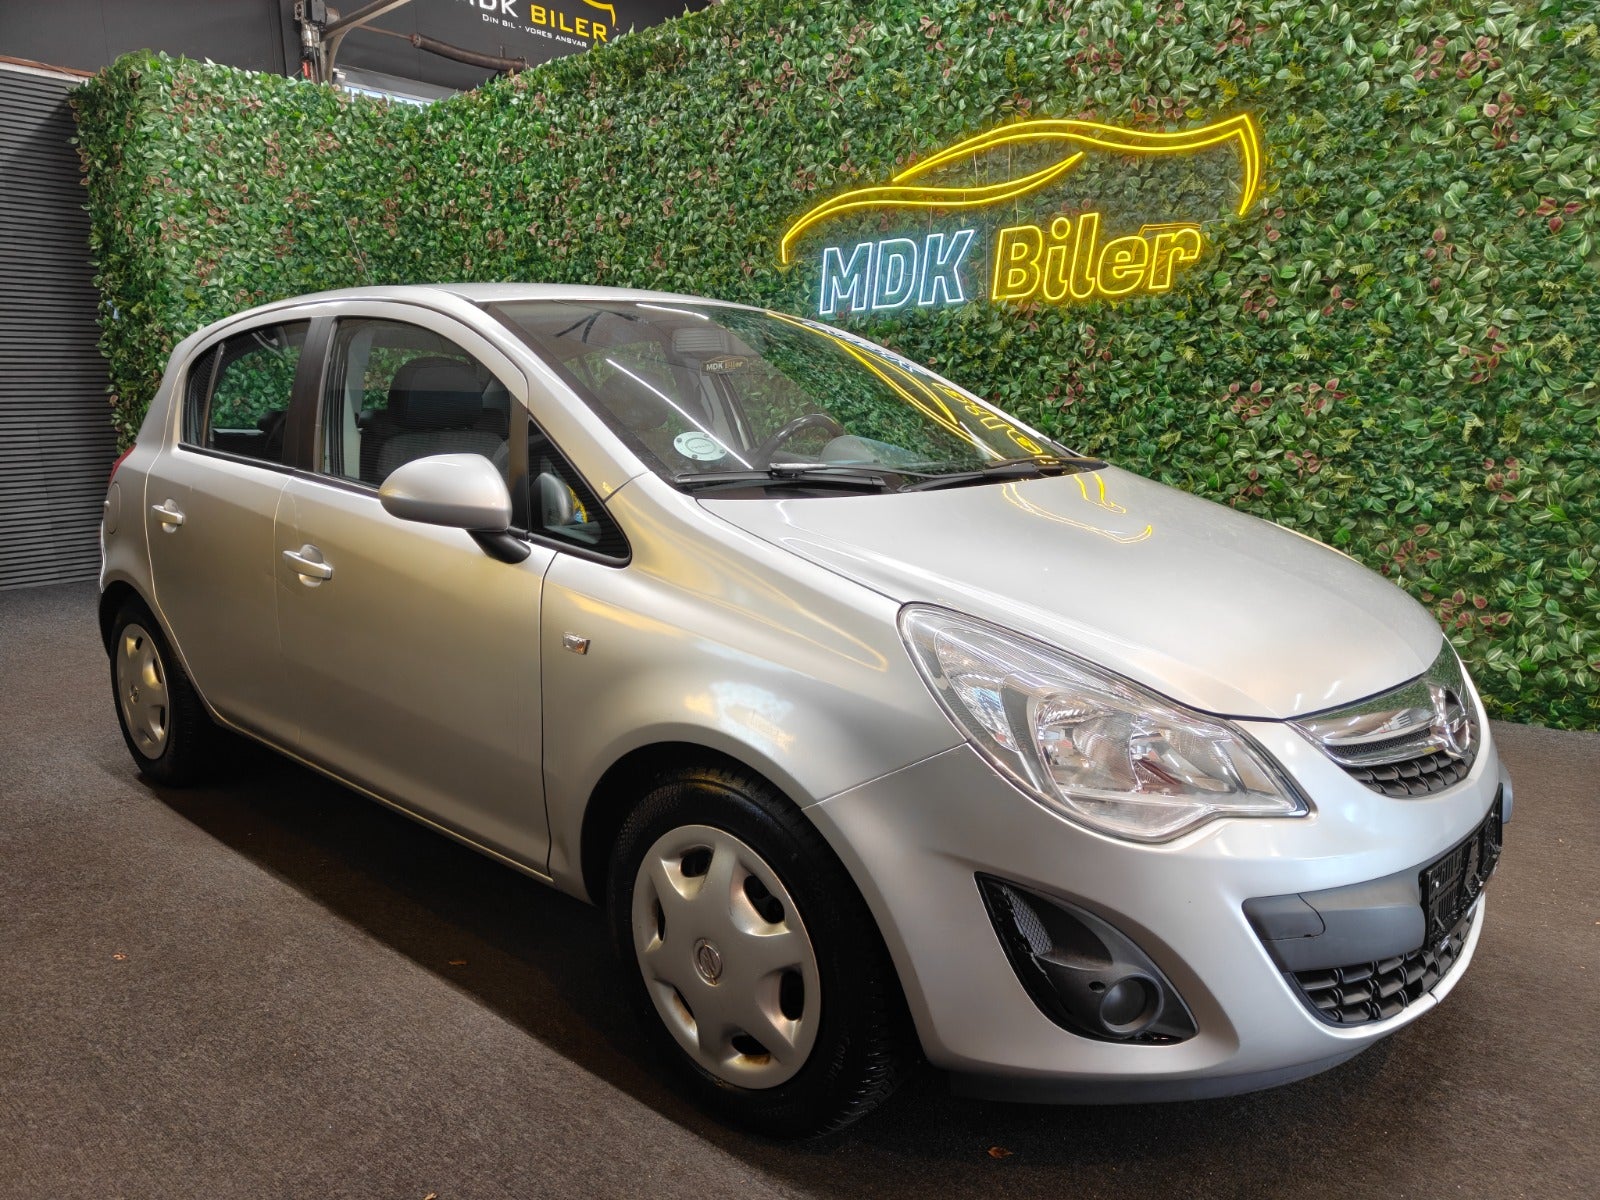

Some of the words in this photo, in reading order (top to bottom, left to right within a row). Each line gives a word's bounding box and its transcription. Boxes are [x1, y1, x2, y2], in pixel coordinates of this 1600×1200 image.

[456, 0, 519, 18] DK
[530, 4, 608, 43] BILER
[482, 13, 499, 24] DIN
[502, 20, 516, 29] BIL
[524, 26, 553, 39] VORES
[555, 34, 588, 48] ANSVAR
[819, 229, 975, 316] MDK
[992, 212, 1202, 300] Biler
[706, 361, 723, 371] MDK
